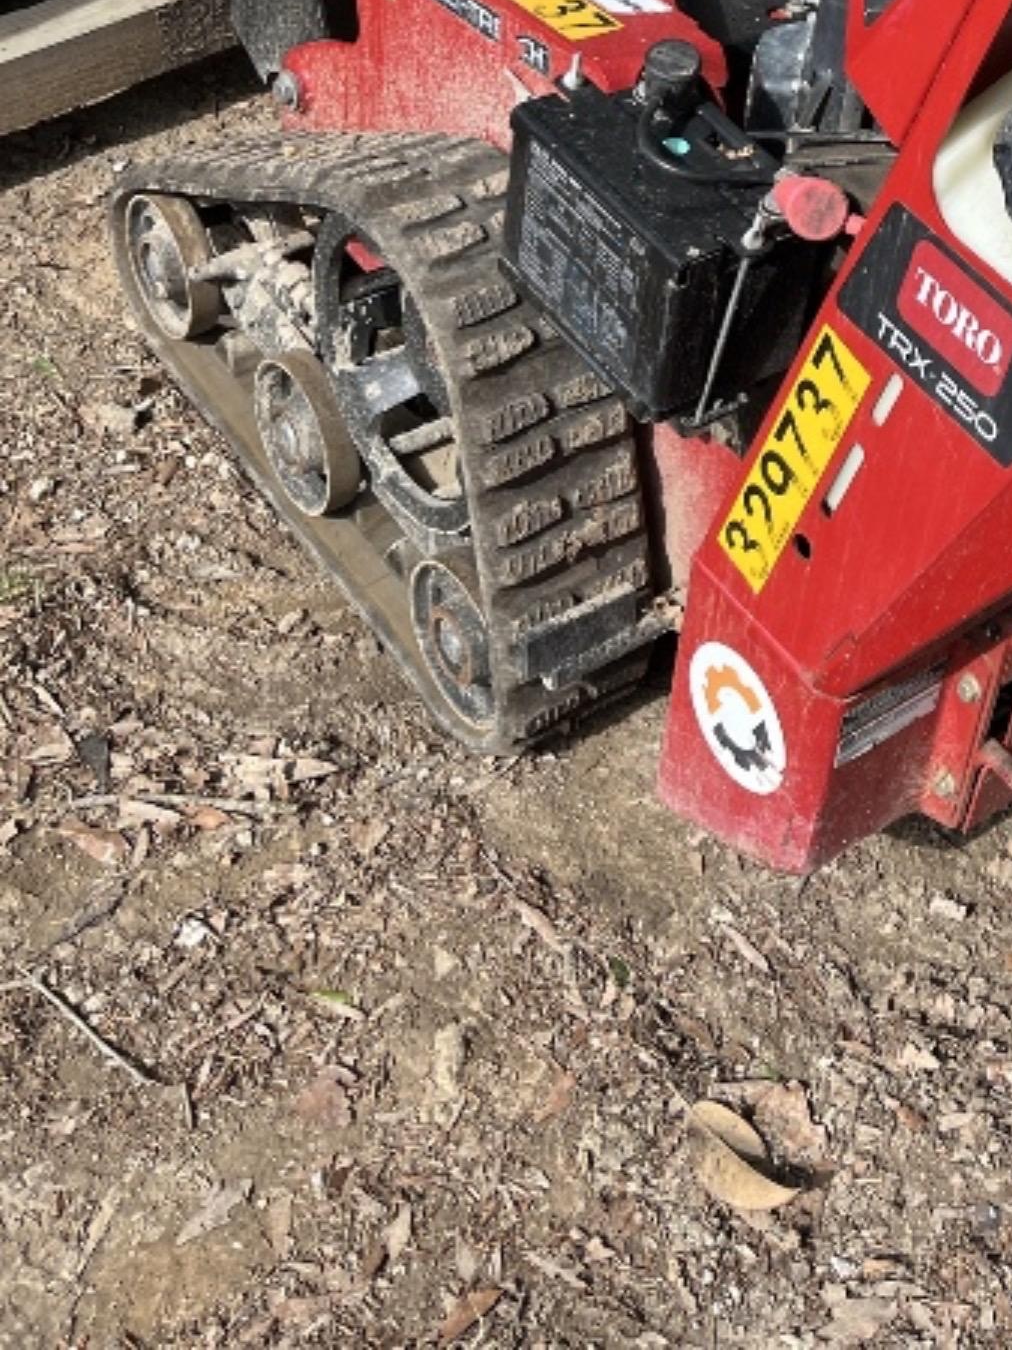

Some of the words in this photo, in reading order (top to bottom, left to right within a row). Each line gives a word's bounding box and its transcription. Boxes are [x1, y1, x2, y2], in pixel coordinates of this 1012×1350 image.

[877, 311, 998, 442] TRX-250
[915, 265, 1003, 365] TORO
[724, 333, 857, 581] 329737
